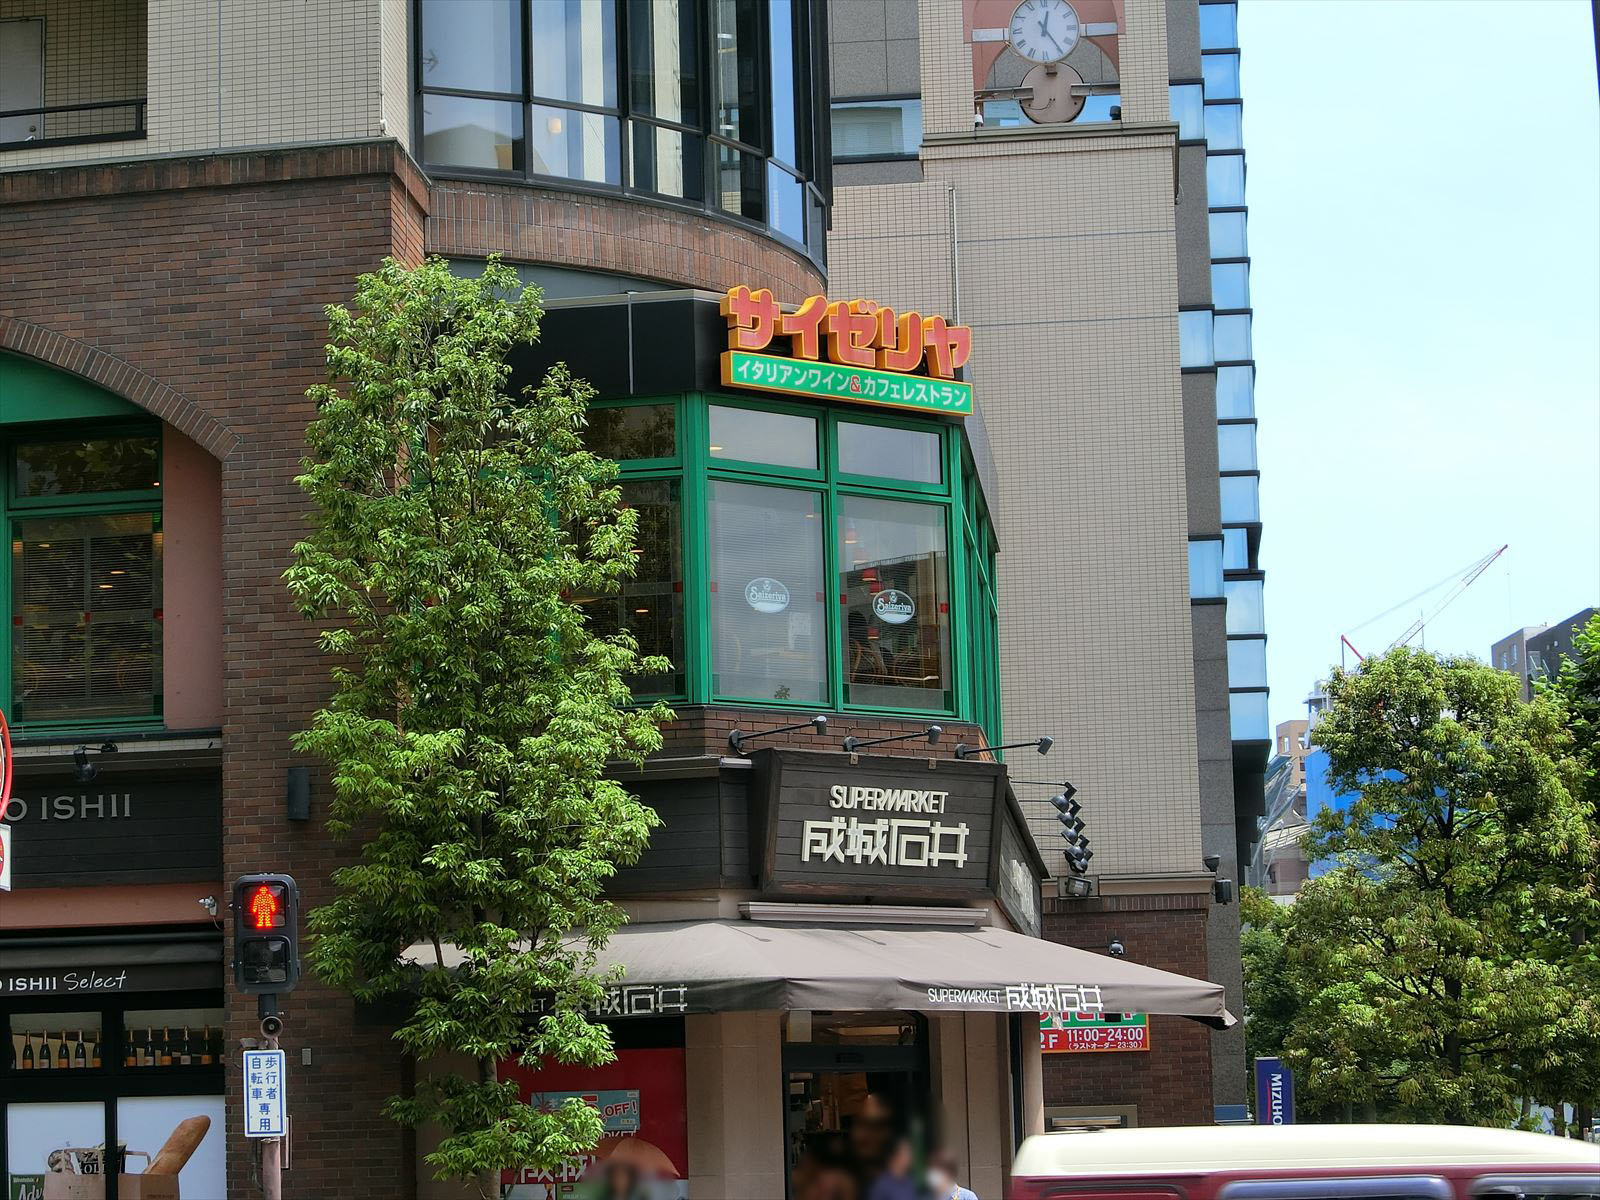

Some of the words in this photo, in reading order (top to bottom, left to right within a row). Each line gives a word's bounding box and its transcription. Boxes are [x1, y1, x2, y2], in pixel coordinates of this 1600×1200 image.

[720, 285, 972, 378] サイゼリヤ
[876, 597, 913, 615] Saizeriya
[40, 793, 131, 820] ISHII
[829, 784, 949, 814] SUPERMARKET
[801, 816, 970, 868] 成城石井
[9, 976, 57, 991] ISHII
[63, 969, 127, 991] Select
[927, 988, 1000, 1004] SUPERMARKET
[1005, 982, 1103, 1012] 成城石井
[1067, 1028, 1143, 1042] 11:00-24:00
[250, 1056, 264, 1100] 自転車
[265, 1056, 278, 1100] 歩行者
[1271, 1073, 1283, 1125] MIZUHO
[258, 1102, 271, 1131] 専用
